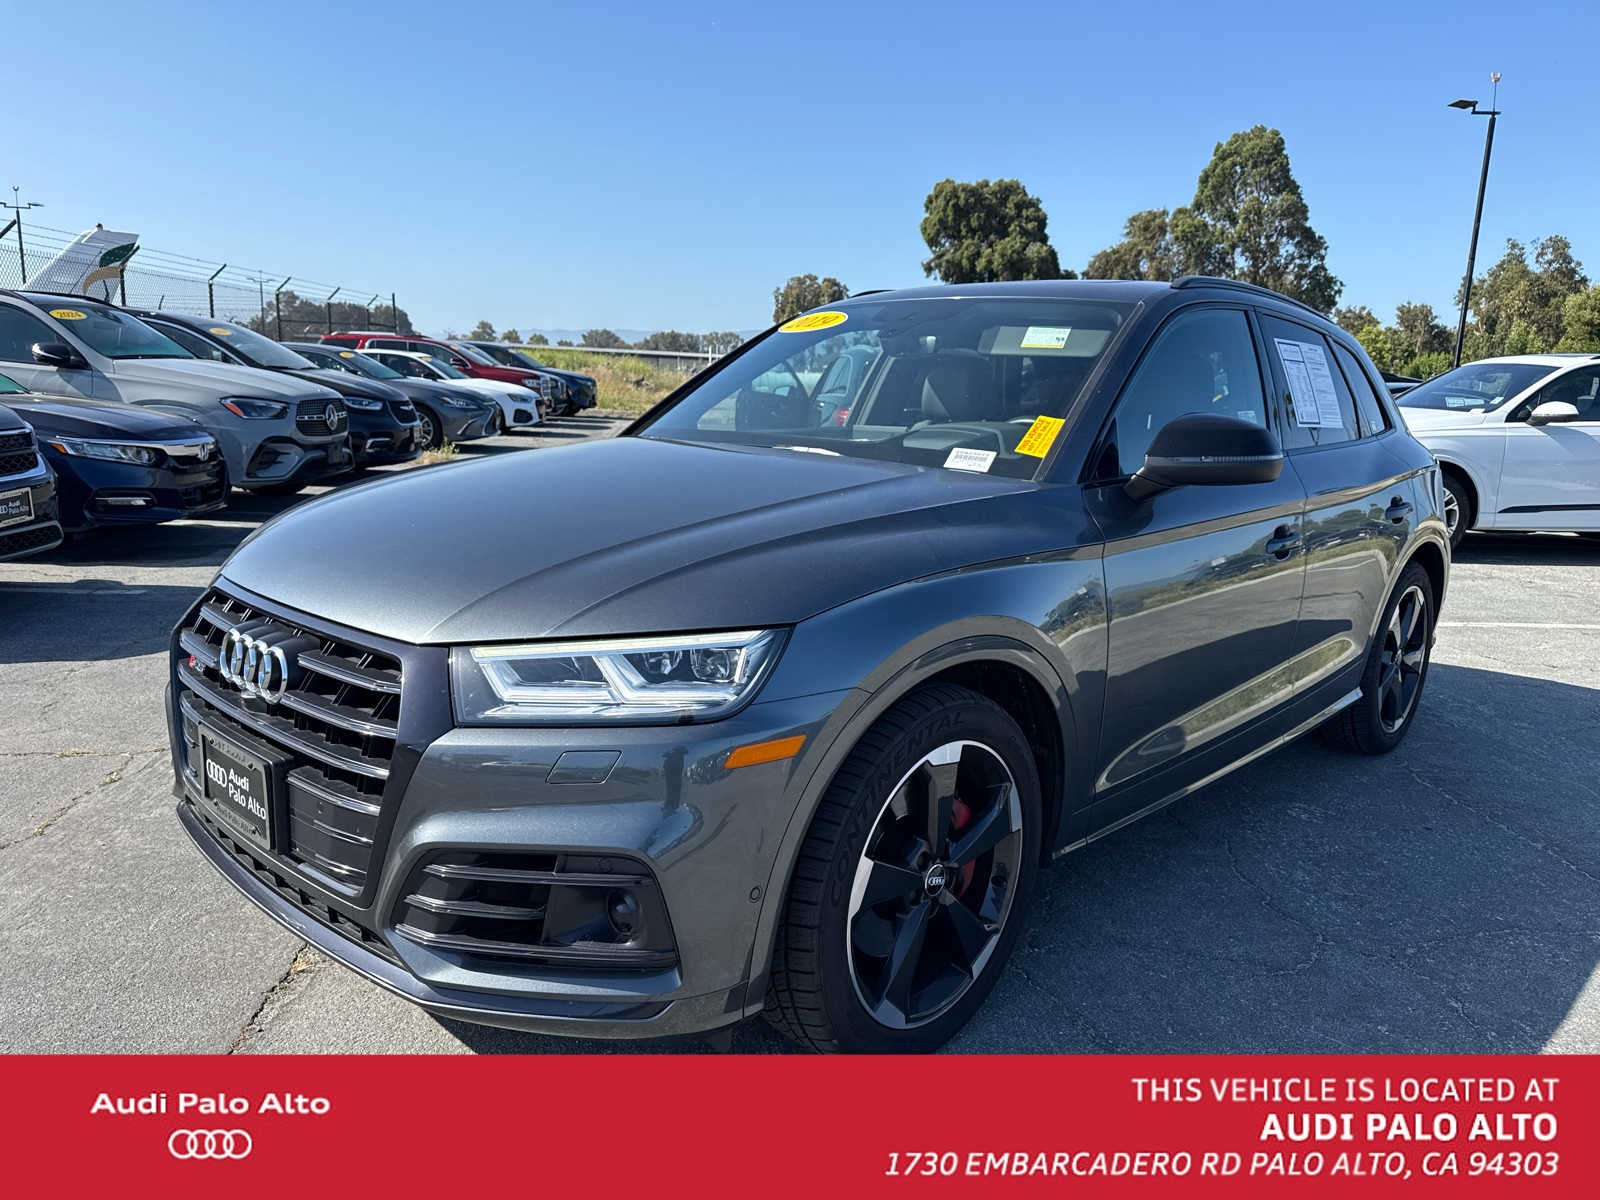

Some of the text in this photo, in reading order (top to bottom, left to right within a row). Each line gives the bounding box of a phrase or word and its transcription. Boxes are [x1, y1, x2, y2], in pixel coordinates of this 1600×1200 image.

[229, 768, 249, 791] Audi
[229, 782, 246, 807] Palo
[248, 796, 266, 819] Alto
